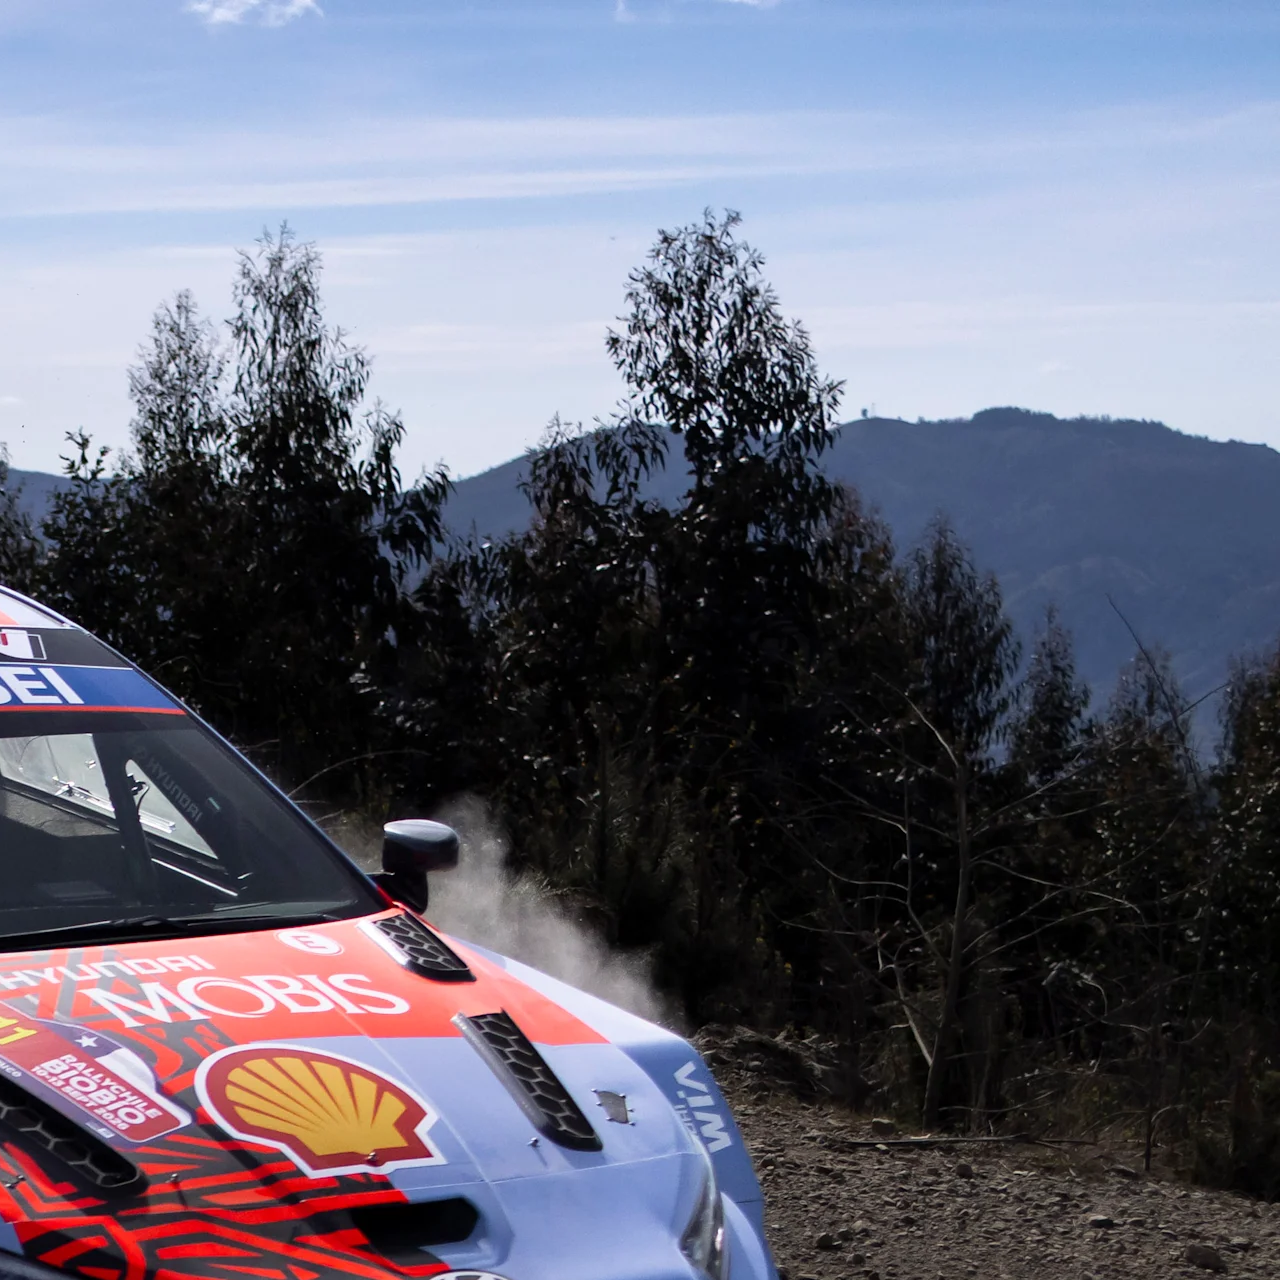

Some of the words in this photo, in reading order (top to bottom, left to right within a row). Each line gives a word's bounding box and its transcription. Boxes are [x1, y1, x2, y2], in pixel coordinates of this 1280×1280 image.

[83, 973, 412, 1028] MOBIS
[30, 1065, 66, 1087] 10-13
[61, 1086, 99, 1107] SEPT
[60, 1053, 163, 1119] RALLYCHILE
